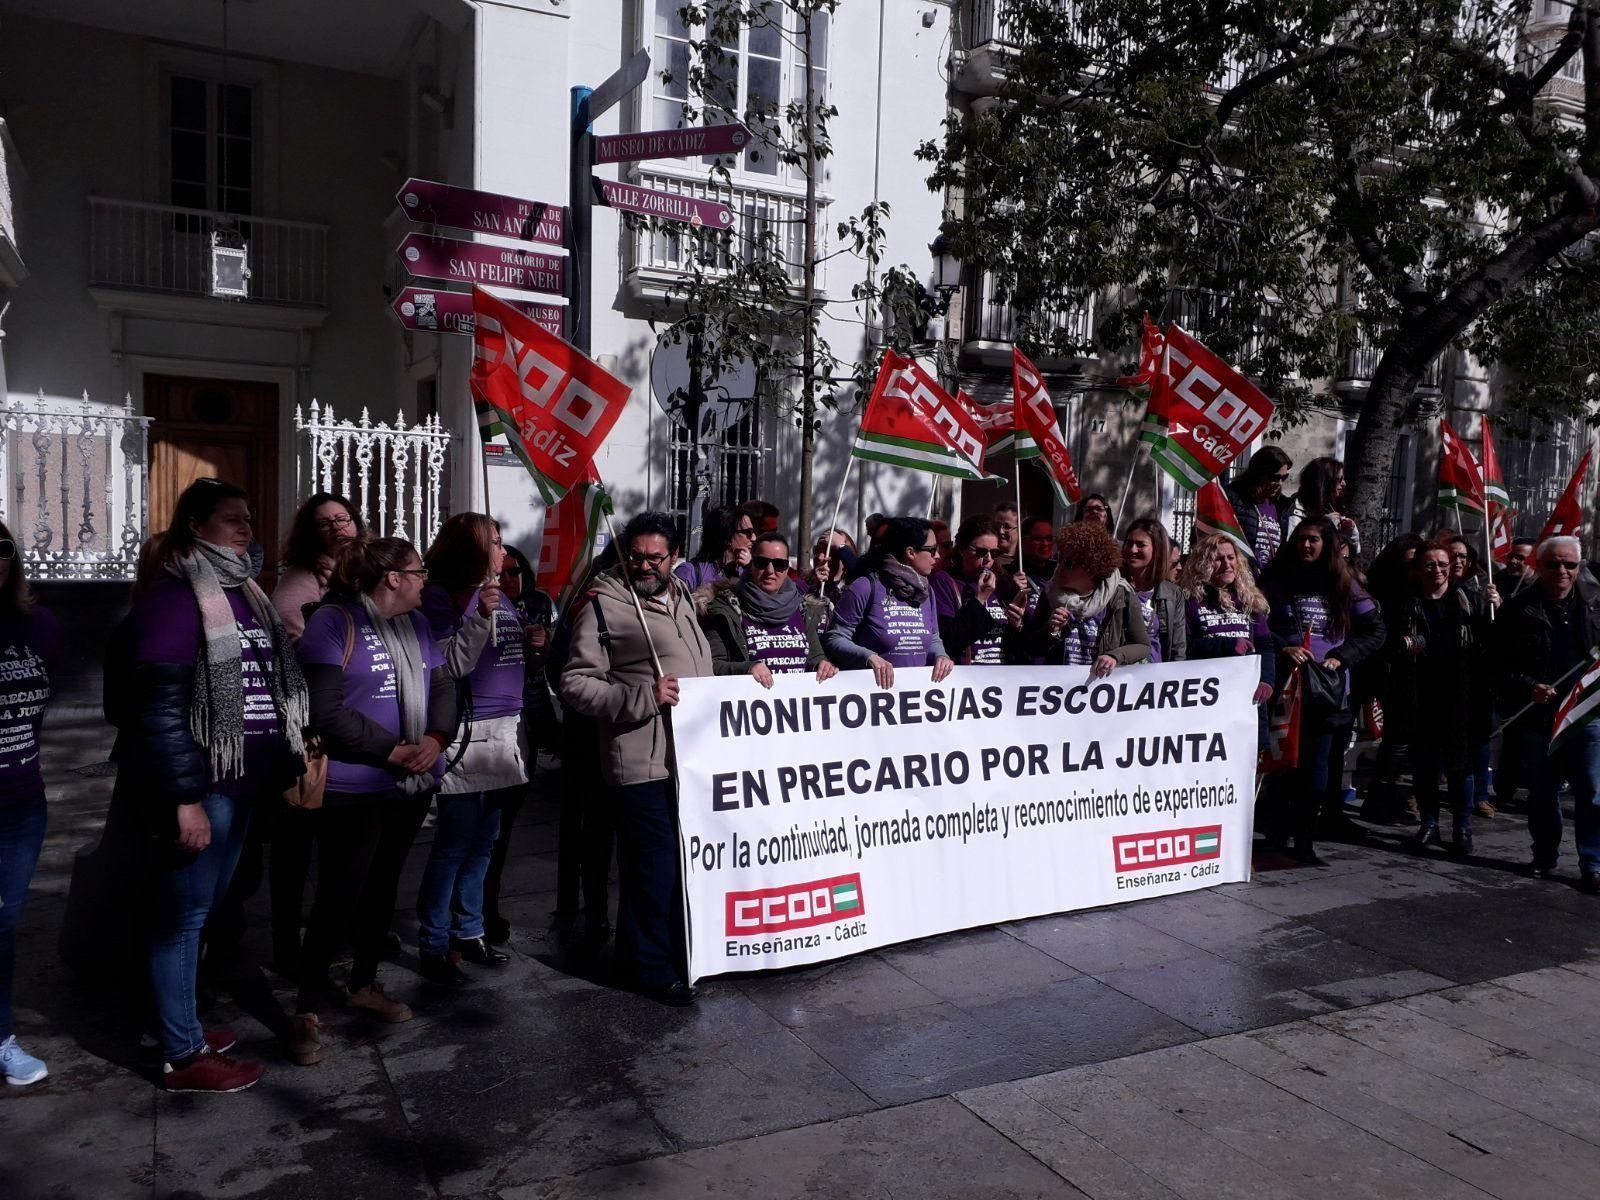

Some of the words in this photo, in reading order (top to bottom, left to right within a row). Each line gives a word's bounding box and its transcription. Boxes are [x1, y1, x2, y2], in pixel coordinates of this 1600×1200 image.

[601, 140, 645, 158] MUSEO
[648, 138, 665, 153] DE
[668, 130, 706, 152] CÁDIZ
[518, 204, 547, 220] PLAZA
[548, 209, 561, 222] DE
[602, 185, 639, 207] CALLE
[642, 194, 701, 218] ZORRILLA
[473, 211, 500, 231] SAN
[503, 216, 561, 241] ANTONIO
[449, 258, 477, 279] SAN
[480, 263, 525, 285] FELIPE
[528, 270, 560, 290] NERI
[501, 251, 545, 269] ORATORIO
[548, 259, 560, 271] DE
[527, 307, 560, 321] MUSEO
[1221, 618, 1247, 626] LUCHA
[754, 634, 804, 643] MONITOR@S
[756, 641, 770, 650] EN
[772, 640, 806, 649] LUCHA
[719, 685, 1003, 738] MONITORES/AS
[1016, 677, 1220, 717] ESCOLARES
[712, 769, 770, 812] EN
[777, 751, 970, 804] PRECARIO
[981, 743, 1050, 782] POR
[1062, 740, 1104, 773] LA
[1115, 732, 1227, 769] JUNTA
[690, 834, 726, 874] Por
[731, 832, 751, 869] la
[757, 816, 853, 866] continuidad,
[855, 809, 921, 860] jornada
[925, 801, 999, 845] completa
[1002, 804, 1011, 839] y
[1014, 787, 1129, 828] reconocimiento
[1132, 784, 1151, 815] de
[1154, 778, 1238, 819] experiencia.
[1118, 834, 1191, 866] CCOO
[1116, 869, 1181, 890] Enseñanza
[1190, 863, 1220, 879] Cádiz
[733, 887, 832, 928] CCOO
[725, 932, 821, 958] Enseñanza
[834, 920, 867, 942] Cádiz
